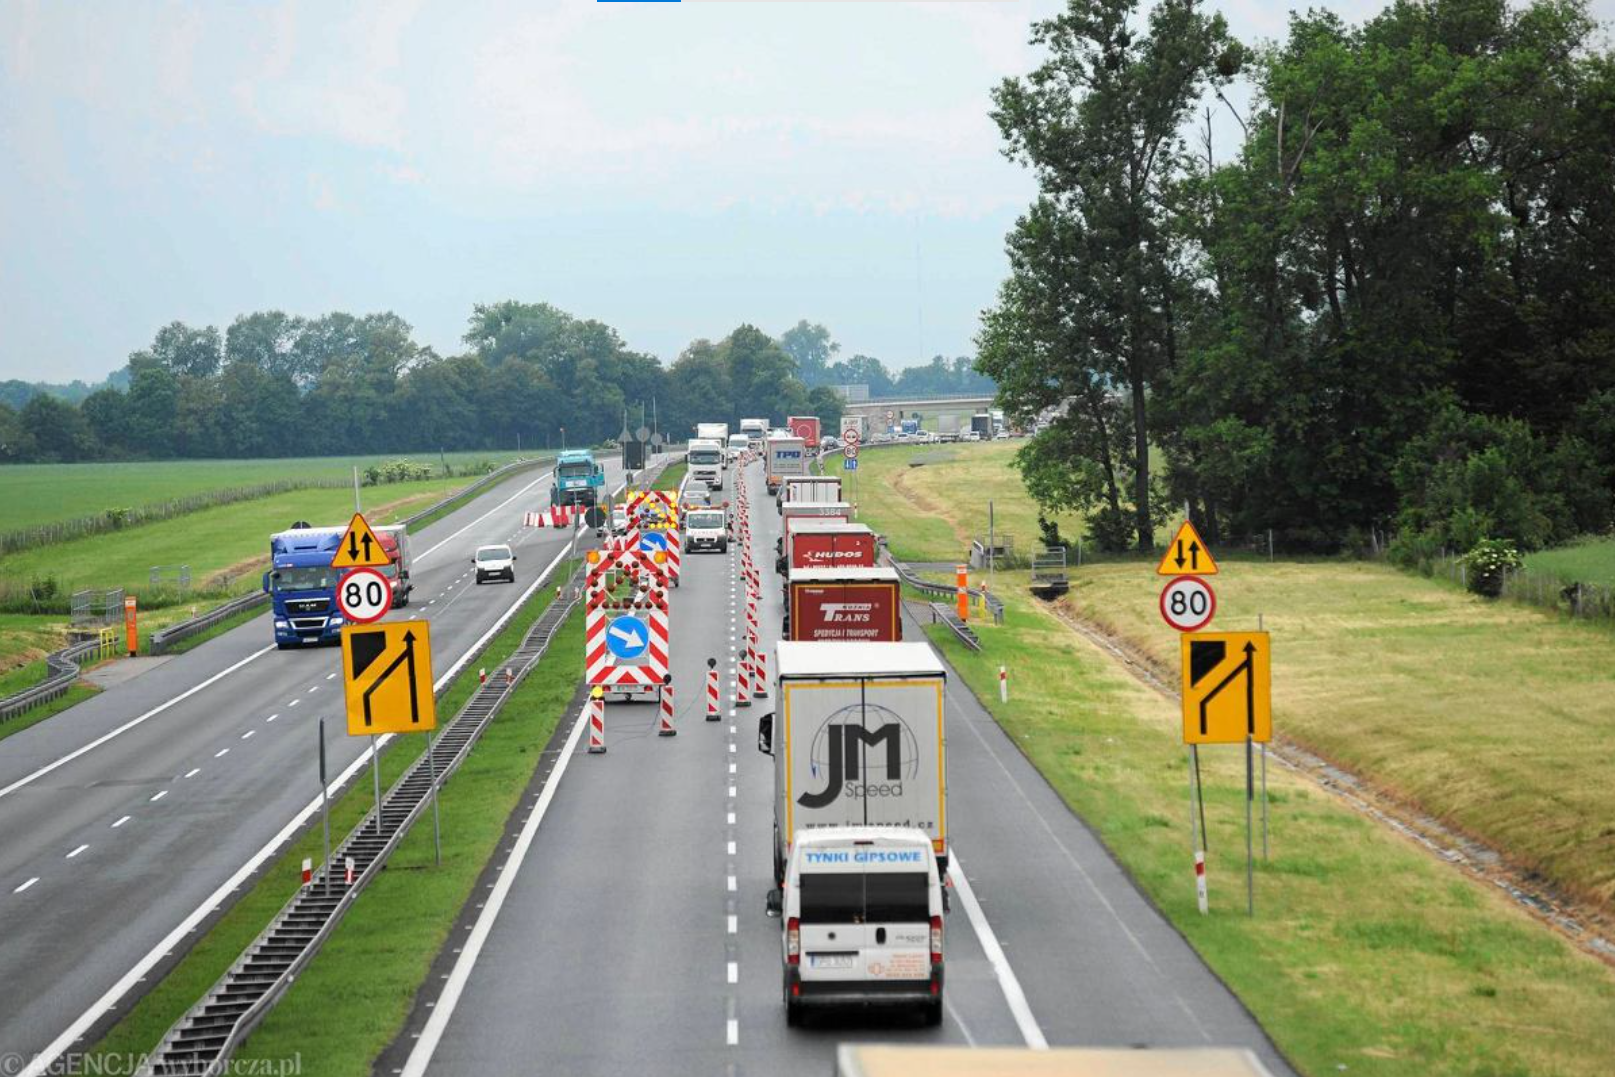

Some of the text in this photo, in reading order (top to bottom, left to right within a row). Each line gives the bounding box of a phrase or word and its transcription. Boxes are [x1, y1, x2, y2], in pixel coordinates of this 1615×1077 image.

[815, 551, 863, 559] HUDOS
[345, 581, 382, 608] 80
[1171, 590, 1207, 616] 80
[820, 603, 870, 621] TRANS
[797, 723, 900, 809] JM
[805, 852, 922, 863] TYNKI GIPSOWE
